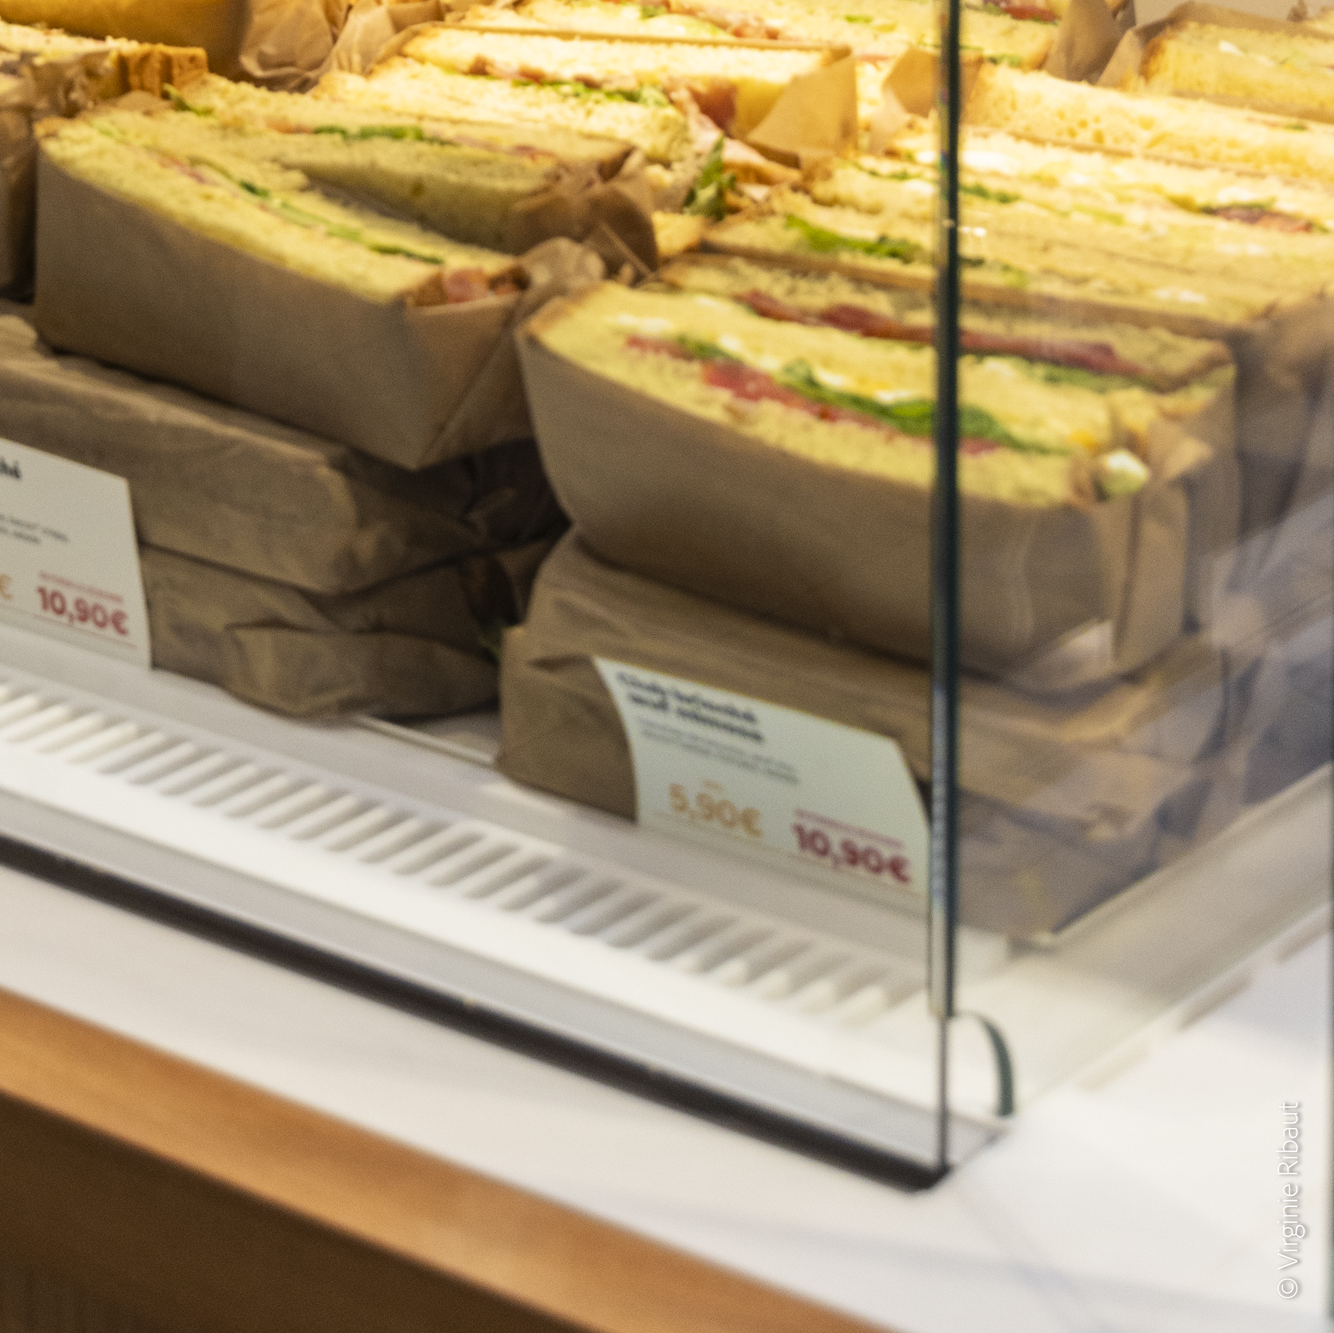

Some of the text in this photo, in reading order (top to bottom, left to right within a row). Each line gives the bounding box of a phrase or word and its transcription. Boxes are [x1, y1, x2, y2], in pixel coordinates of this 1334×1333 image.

[37, 586, 127, 635] 10,90€
[669, 784, 762, 838] 5,90€
[794, 824, 908, 883] 10,90€
